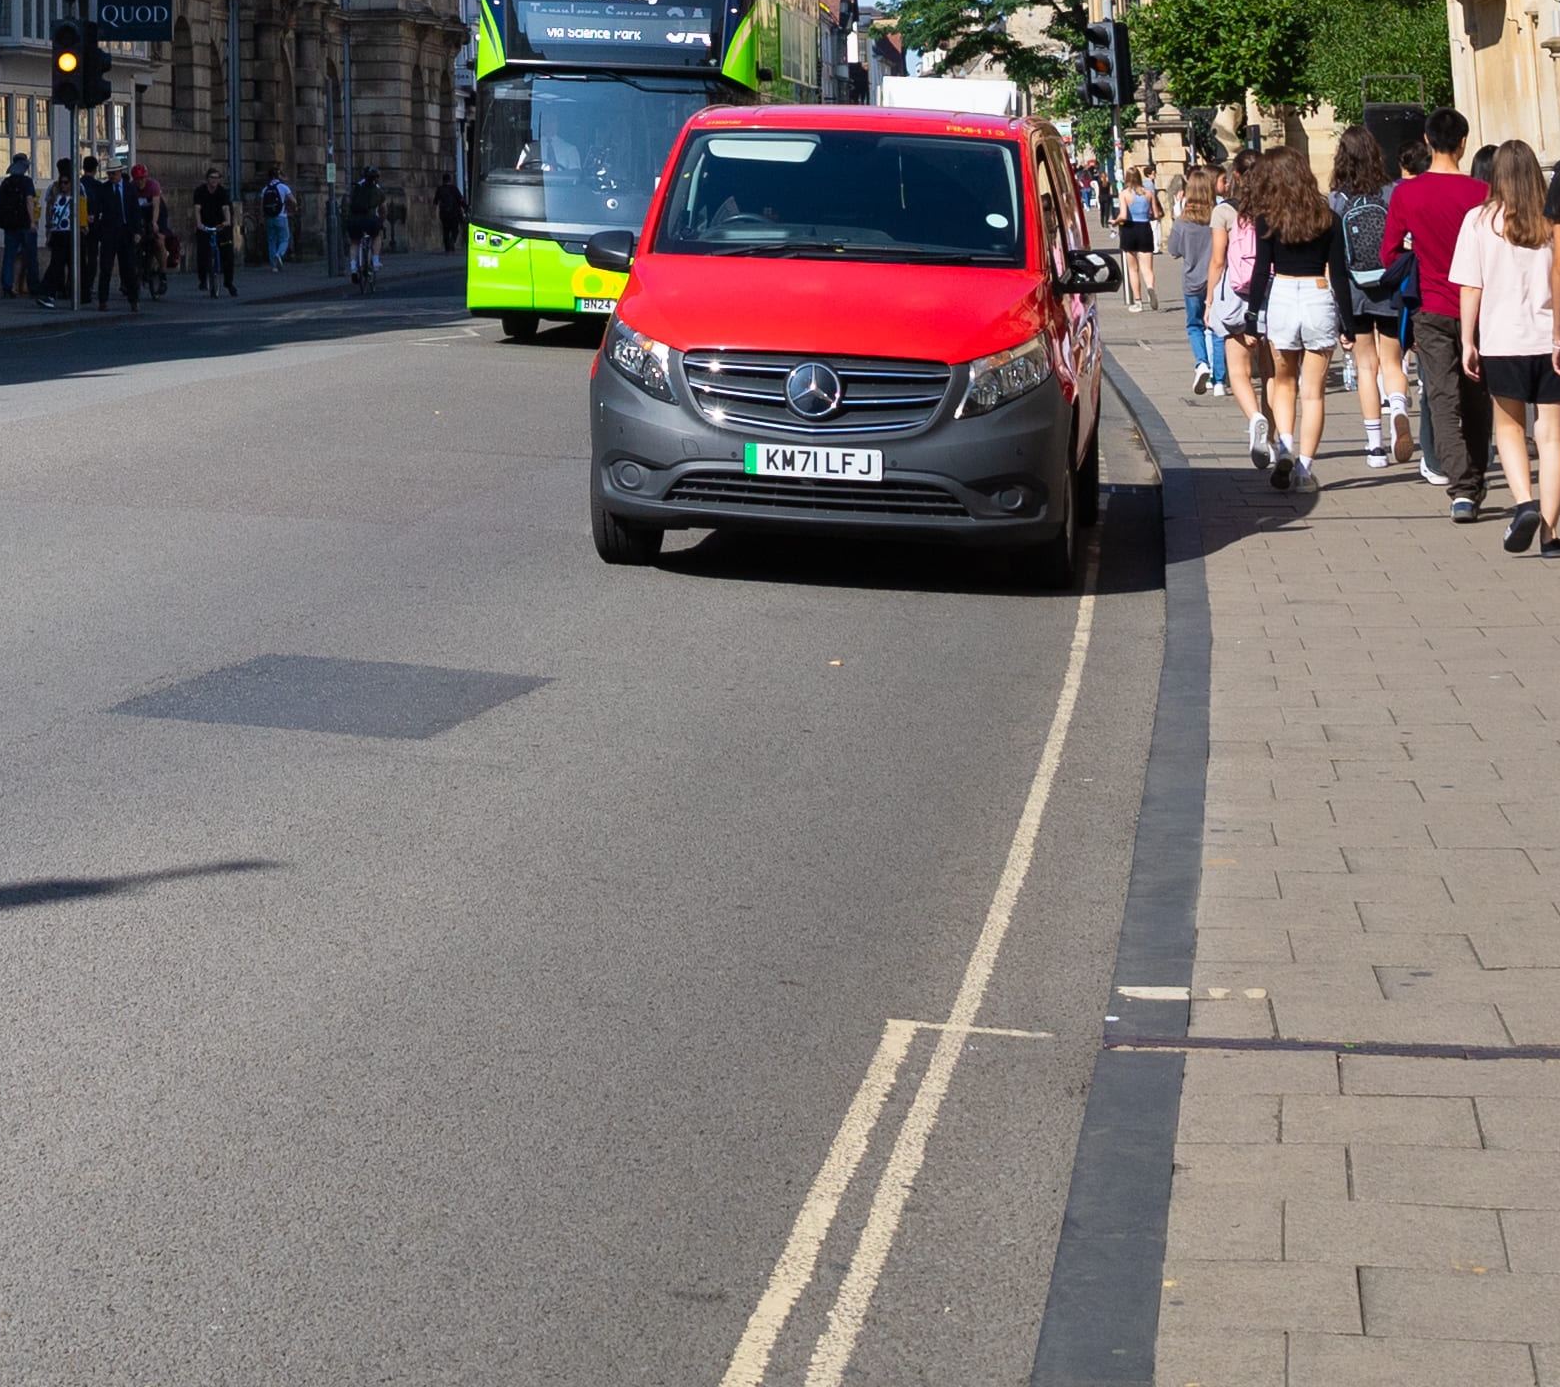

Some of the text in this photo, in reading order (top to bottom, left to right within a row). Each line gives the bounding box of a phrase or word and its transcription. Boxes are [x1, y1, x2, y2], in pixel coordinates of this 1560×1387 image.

[101, 4, 168, 27] QUOD
[477, 255, 499, 269] 754
[583, 300, 611, 310] BN24
[766, 448, 872, 475] KM71 LFJ
